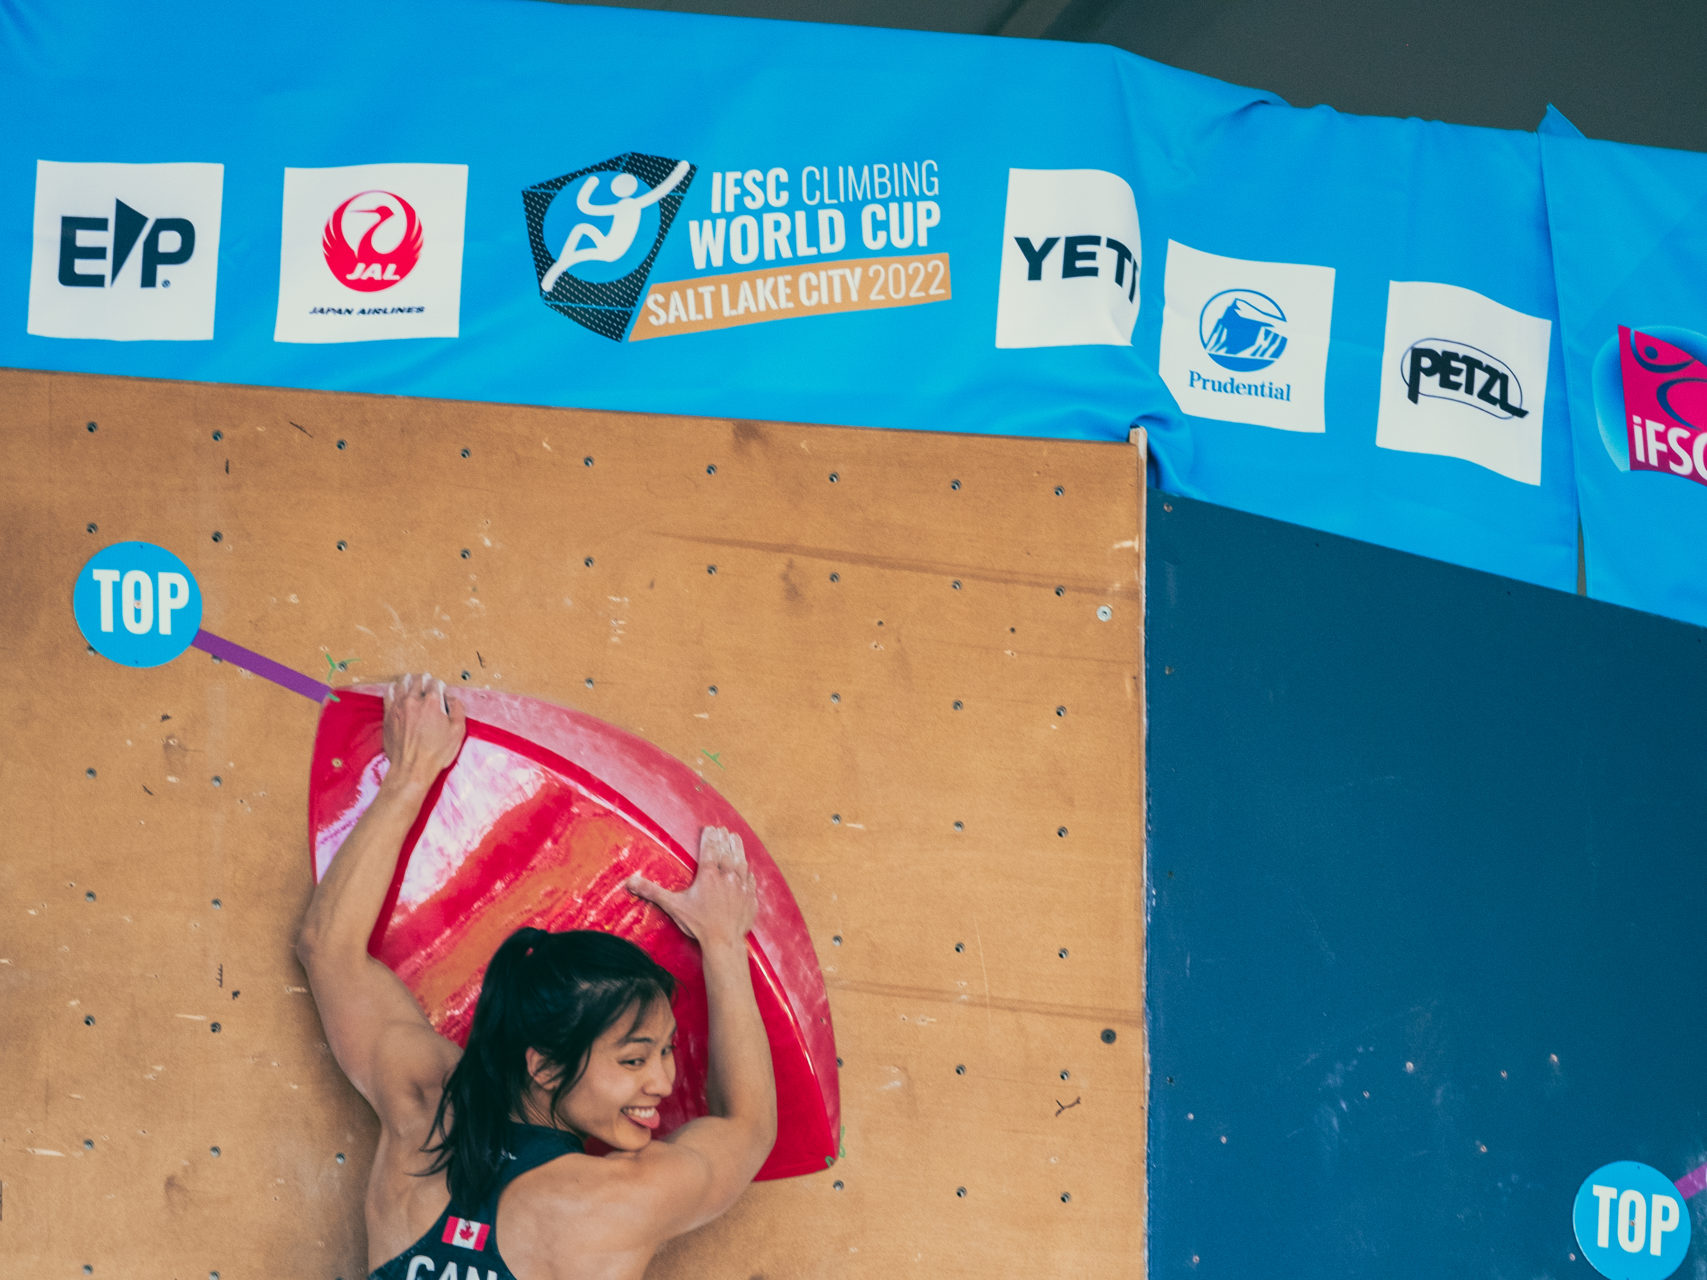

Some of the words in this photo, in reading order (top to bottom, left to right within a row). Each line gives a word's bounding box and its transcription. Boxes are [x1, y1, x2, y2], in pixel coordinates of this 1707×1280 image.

[710, 166, 790, 214] IFSC
[801, 159, 940, 206] CLIMBING
[688, 209, 847, 270] WORLD
[861, 200, 941, 250] CUP
[345, 262, 401, 281] JAL
[646, 282, 716, 326] SALT
[722, 273, 793, 318] LAKE
[798, 266, 863, 309] CITY
[868, 259, 946, 301] 2022
[308, 306, 355, 315] JAPAN
[357, 306, 425, 315] AIRLINES
[1188, 370, 1292, 402] Prudential
[1407, 346, 1529, 418] PETZL
[92, 568, 190, 636] TOP
[1592, 1184, 1680, 1257] TOP
